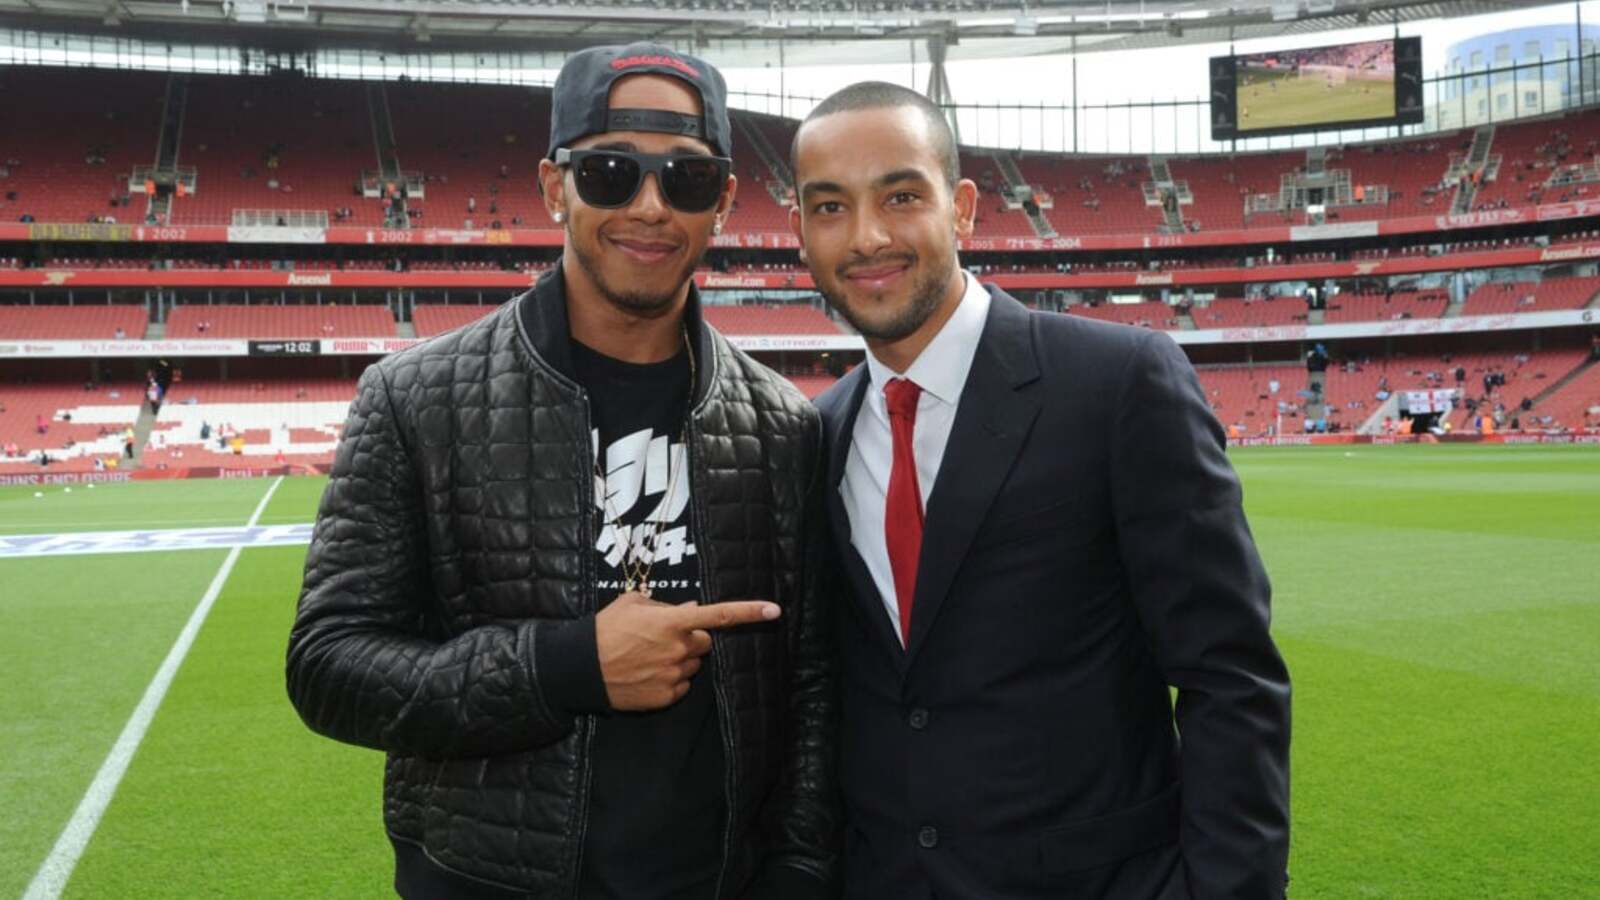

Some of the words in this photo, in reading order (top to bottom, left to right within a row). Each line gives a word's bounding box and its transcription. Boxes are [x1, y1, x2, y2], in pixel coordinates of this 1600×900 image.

[153, 229, 187, 239] 2002
[381, 231, 413, 242] 2002
[288, 273, 331, 285] Arsenal
[704, 276, 766, 287] Arsenal.com
[1136, 272, 1172, 285] Arsenal
[284, 342, 312, 352] 12:02
[648, 580, 688, 589] BOYS
